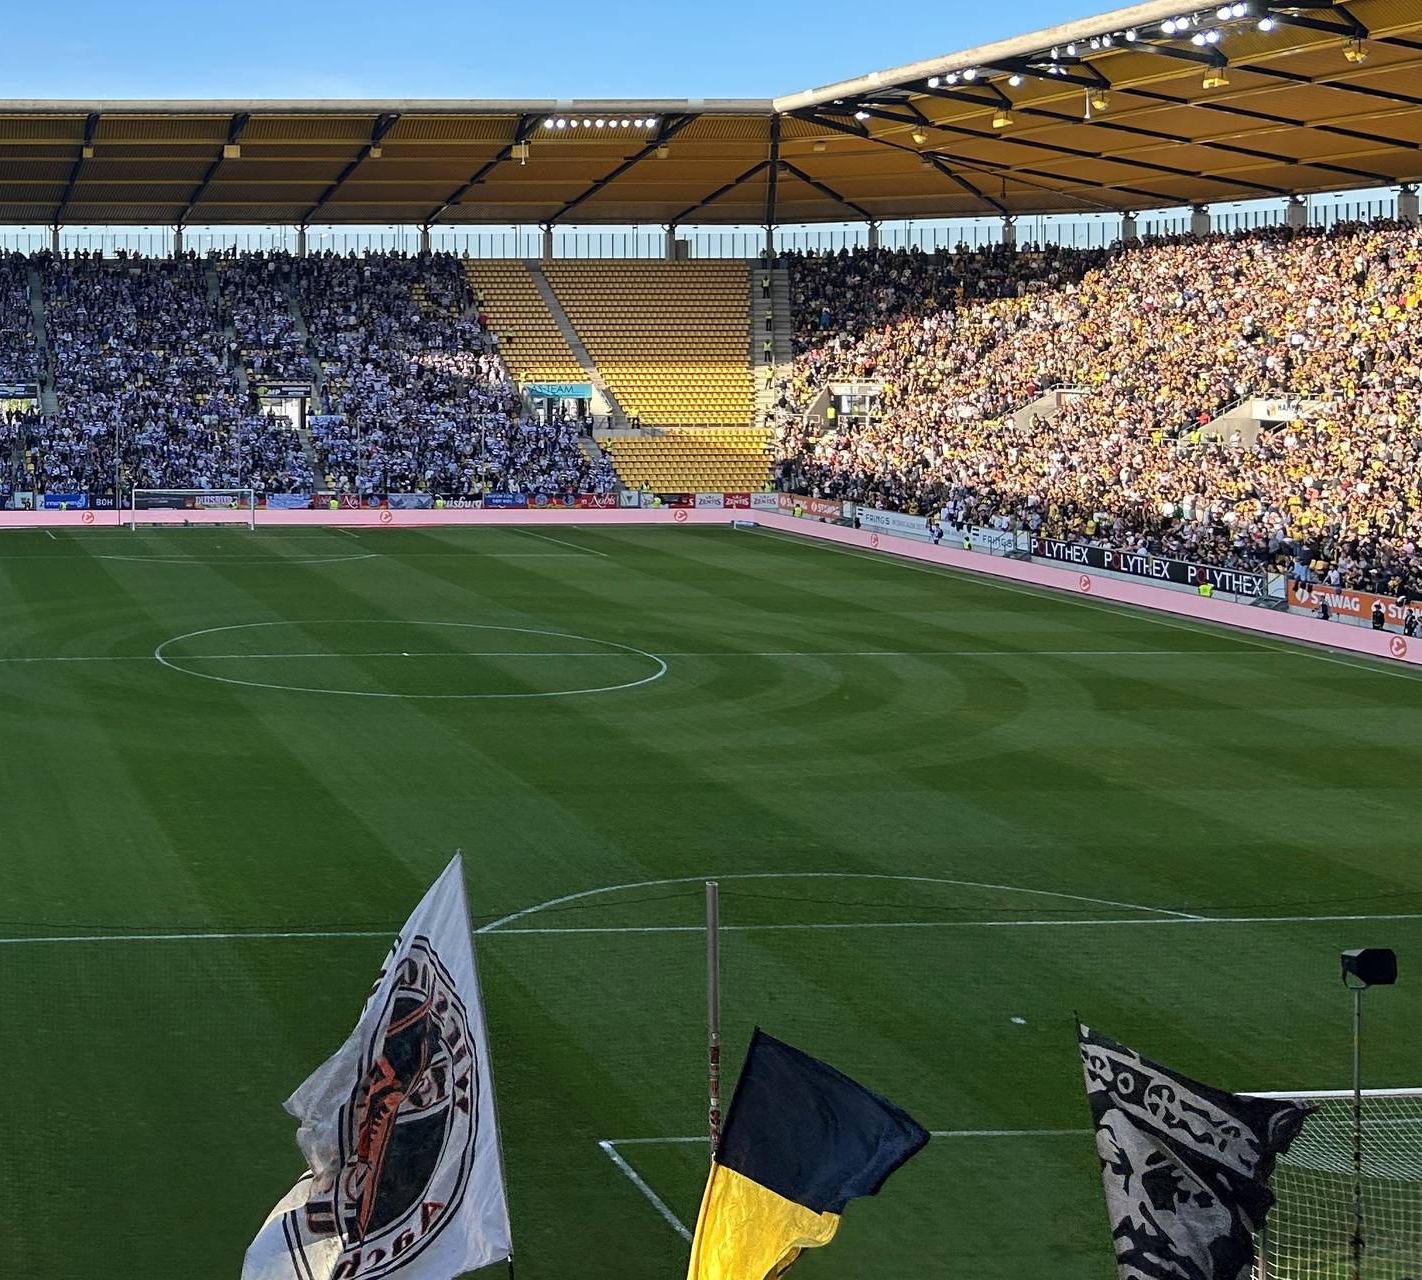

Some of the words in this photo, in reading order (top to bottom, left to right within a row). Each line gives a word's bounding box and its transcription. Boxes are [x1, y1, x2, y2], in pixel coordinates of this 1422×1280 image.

[194, 495, 238, 505] DUISBUR
[725, 497, 750, 506] ZENTIS
[1030, 538, 1089, 565] POLYTHEX
[1104, 551, 1171, 579] POLYTHEX
